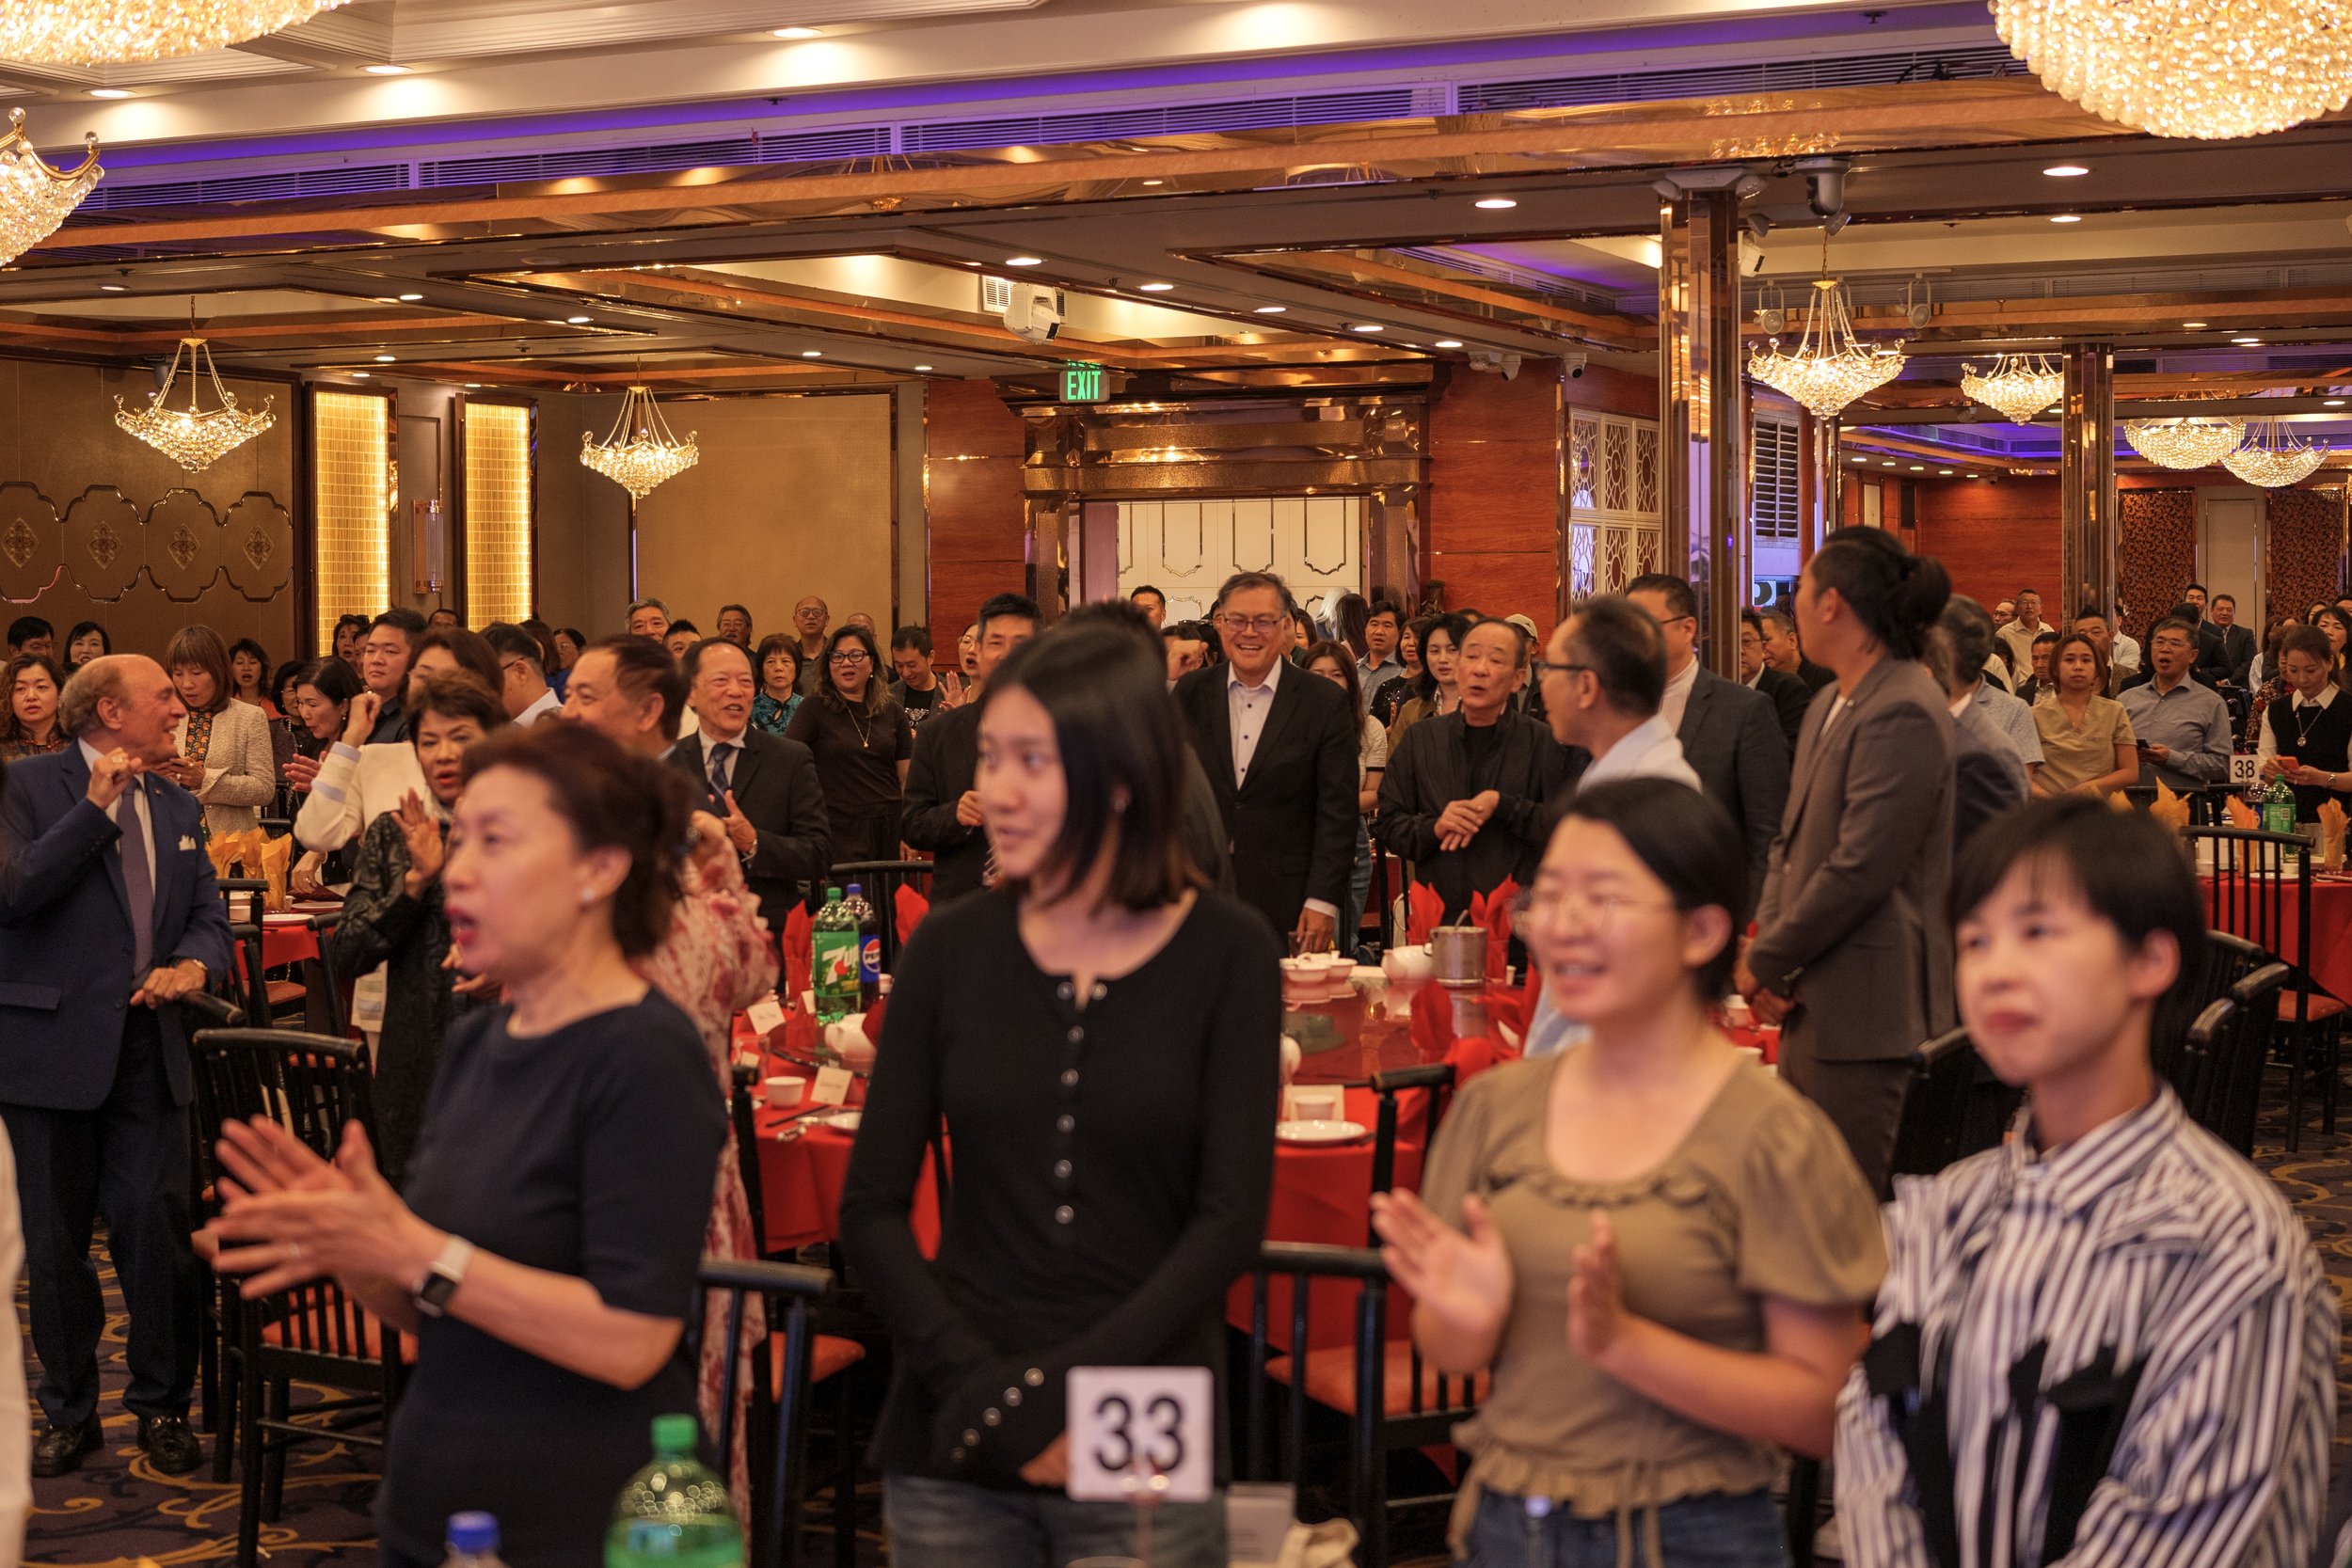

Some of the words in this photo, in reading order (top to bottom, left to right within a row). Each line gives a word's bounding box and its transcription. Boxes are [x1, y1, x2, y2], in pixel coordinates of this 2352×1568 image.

[1067, 371, 1101, 400] EXIT
[2234, 759, 2255, 779] 38
[1095, 1396, 1184, 1472] 33
